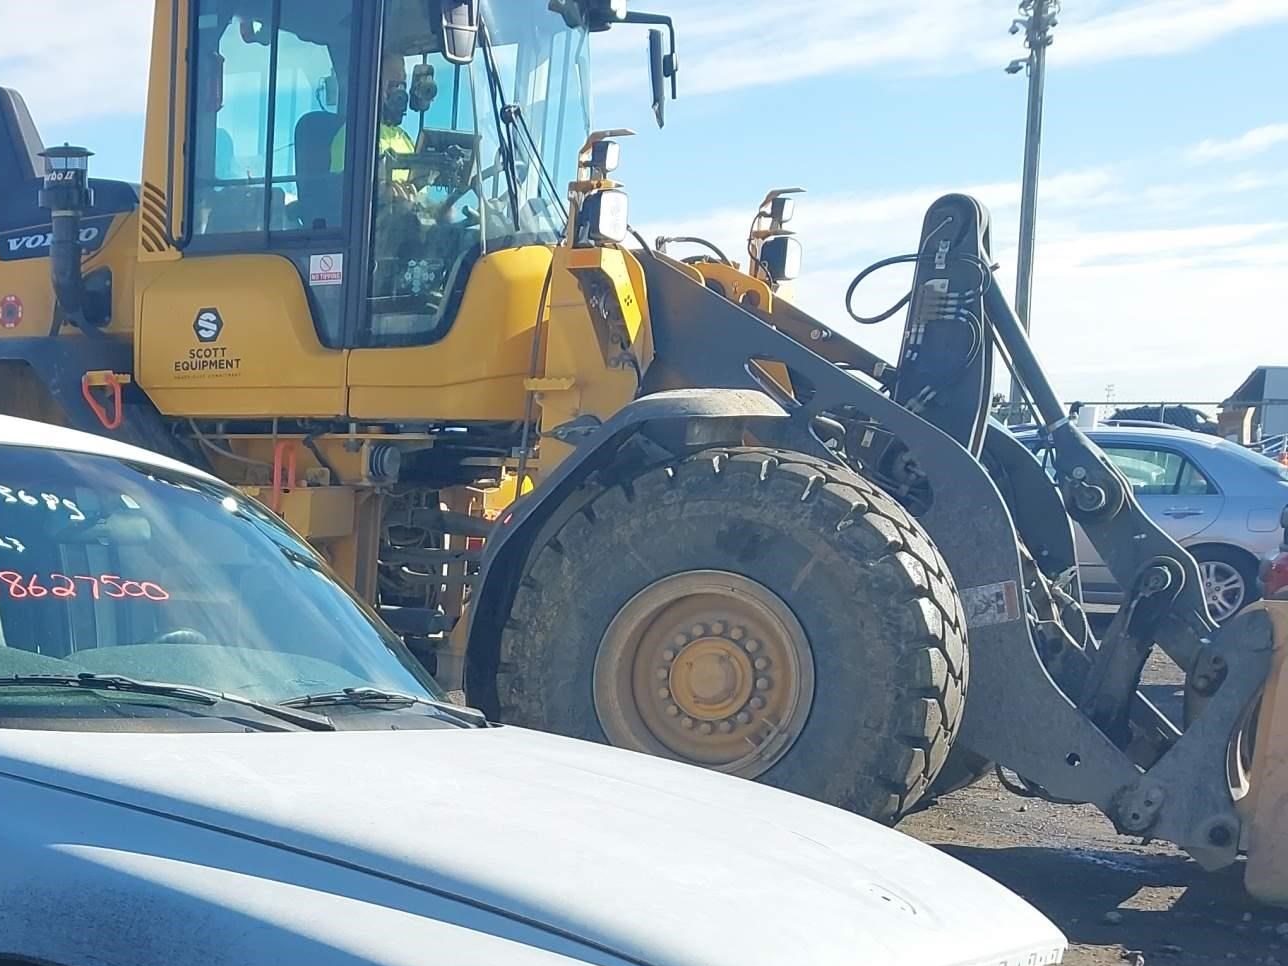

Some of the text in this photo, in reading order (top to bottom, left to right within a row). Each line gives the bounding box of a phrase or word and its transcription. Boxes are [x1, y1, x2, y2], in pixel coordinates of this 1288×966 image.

[8, 227, 98, 251] VOLO
[188, 347, 227, 359] SCOTT
[174, 358, 241, 372] EQUIPMENT
